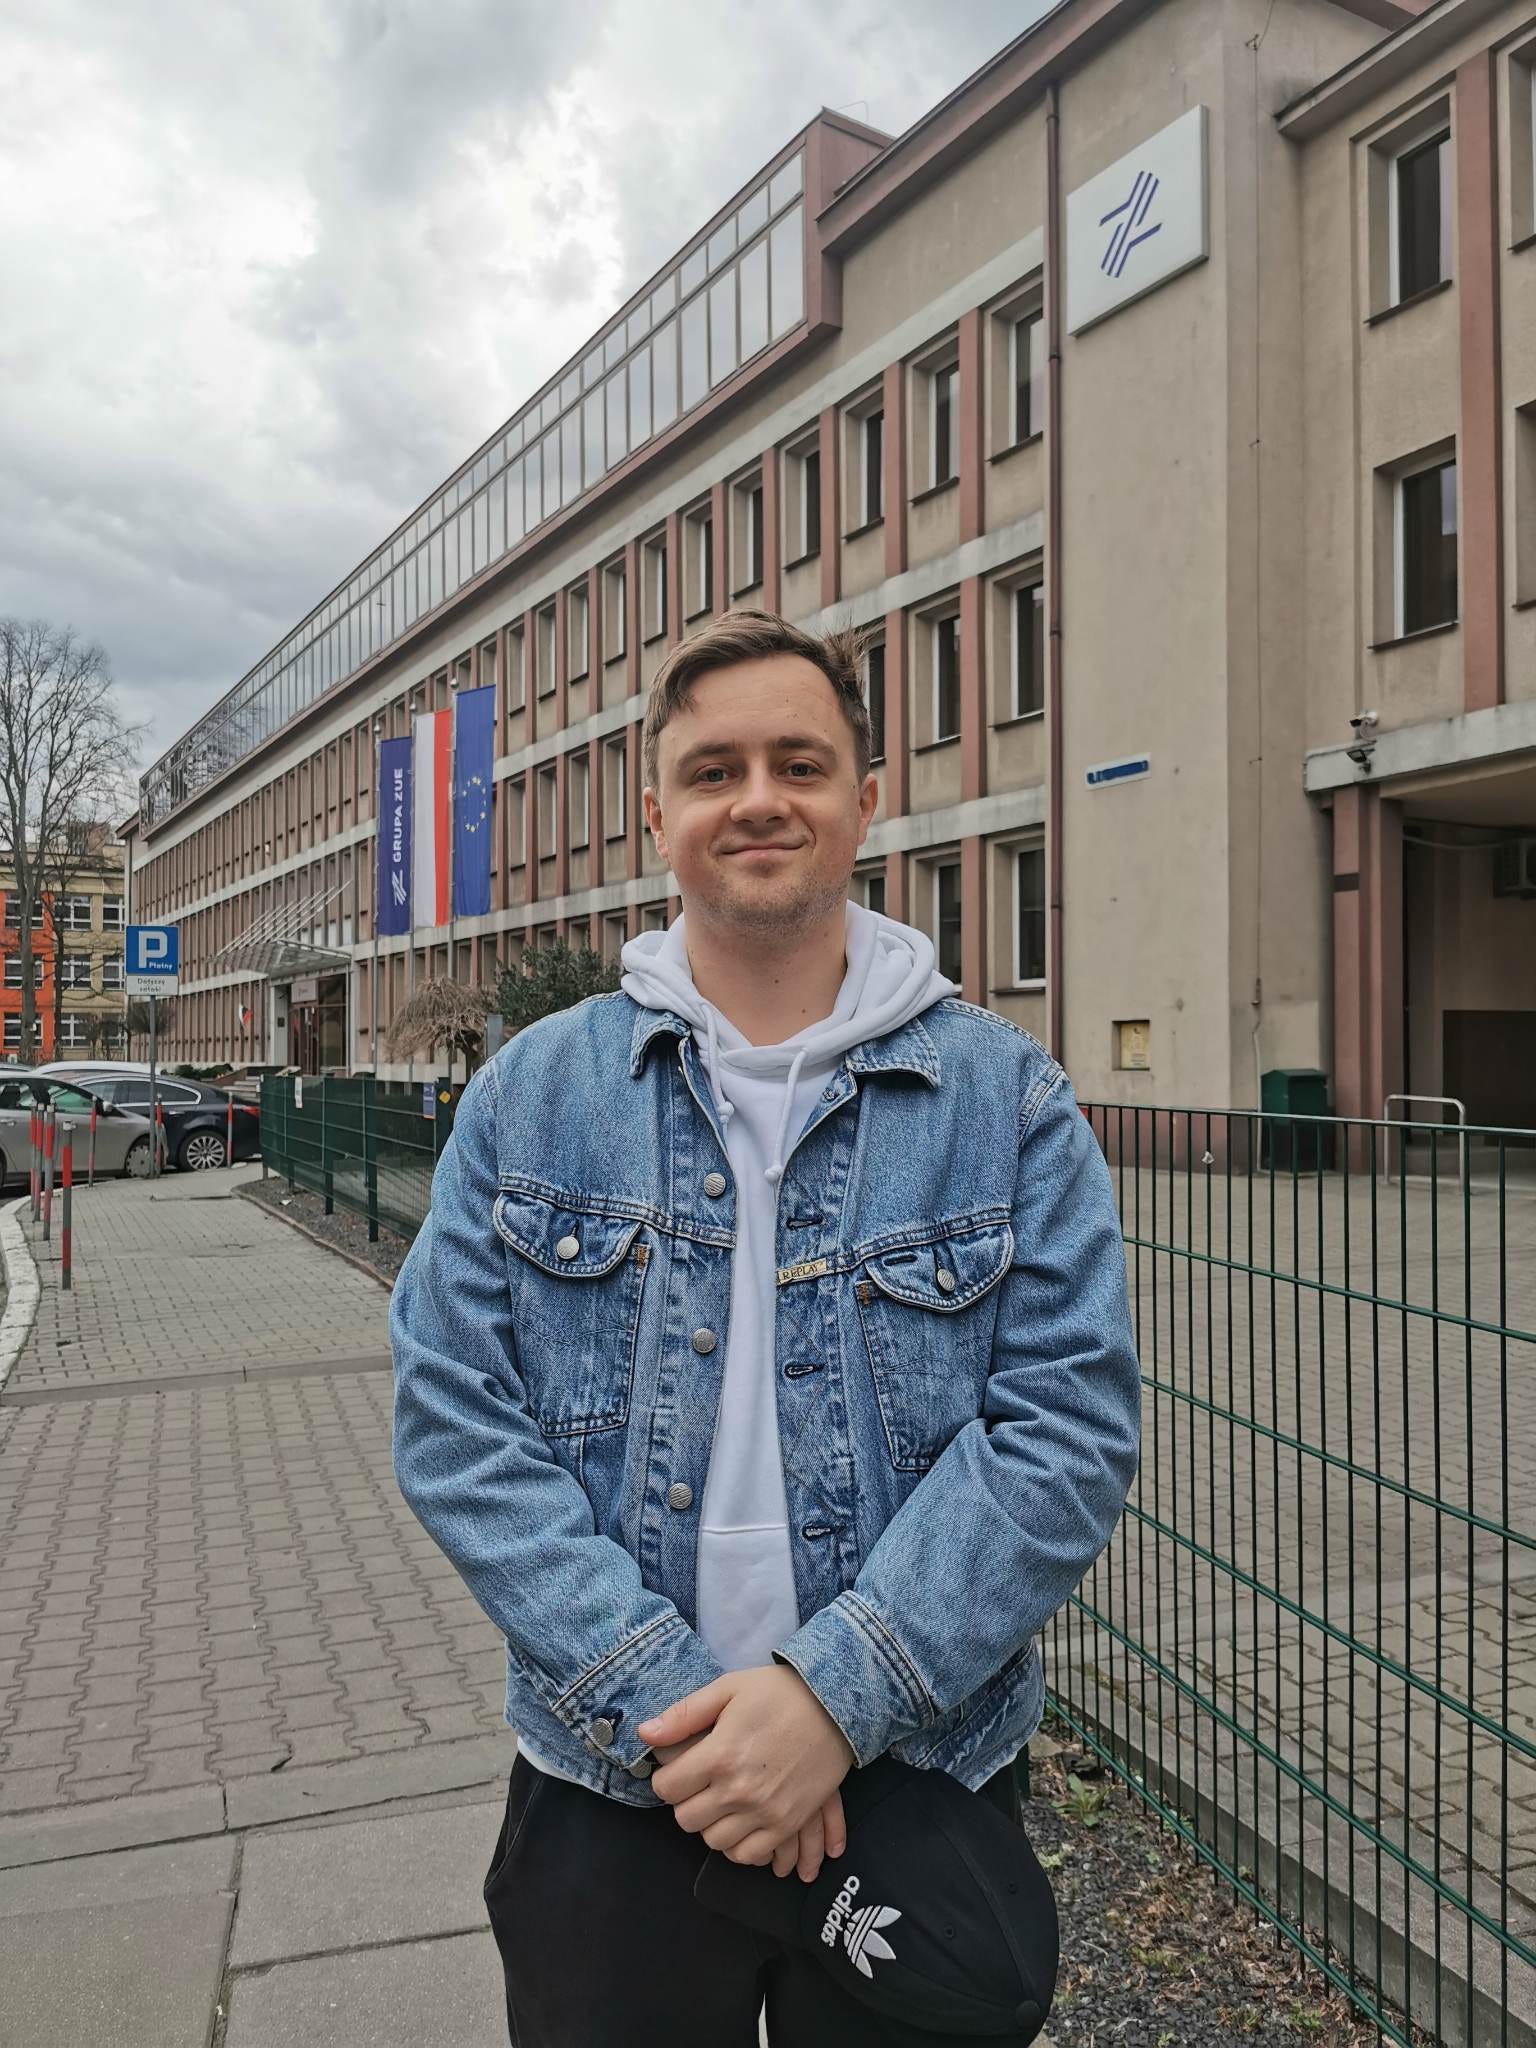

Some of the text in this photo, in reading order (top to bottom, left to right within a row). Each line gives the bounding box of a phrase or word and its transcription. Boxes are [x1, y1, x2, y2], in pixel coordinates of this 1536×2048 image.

[393, 768, 404, 863] GRUPA ZUE
[138, 931, 168, 969] P
[782, 1262, 819, 1280] REPLAY
[821, 1875, 860, 1947] adidas
